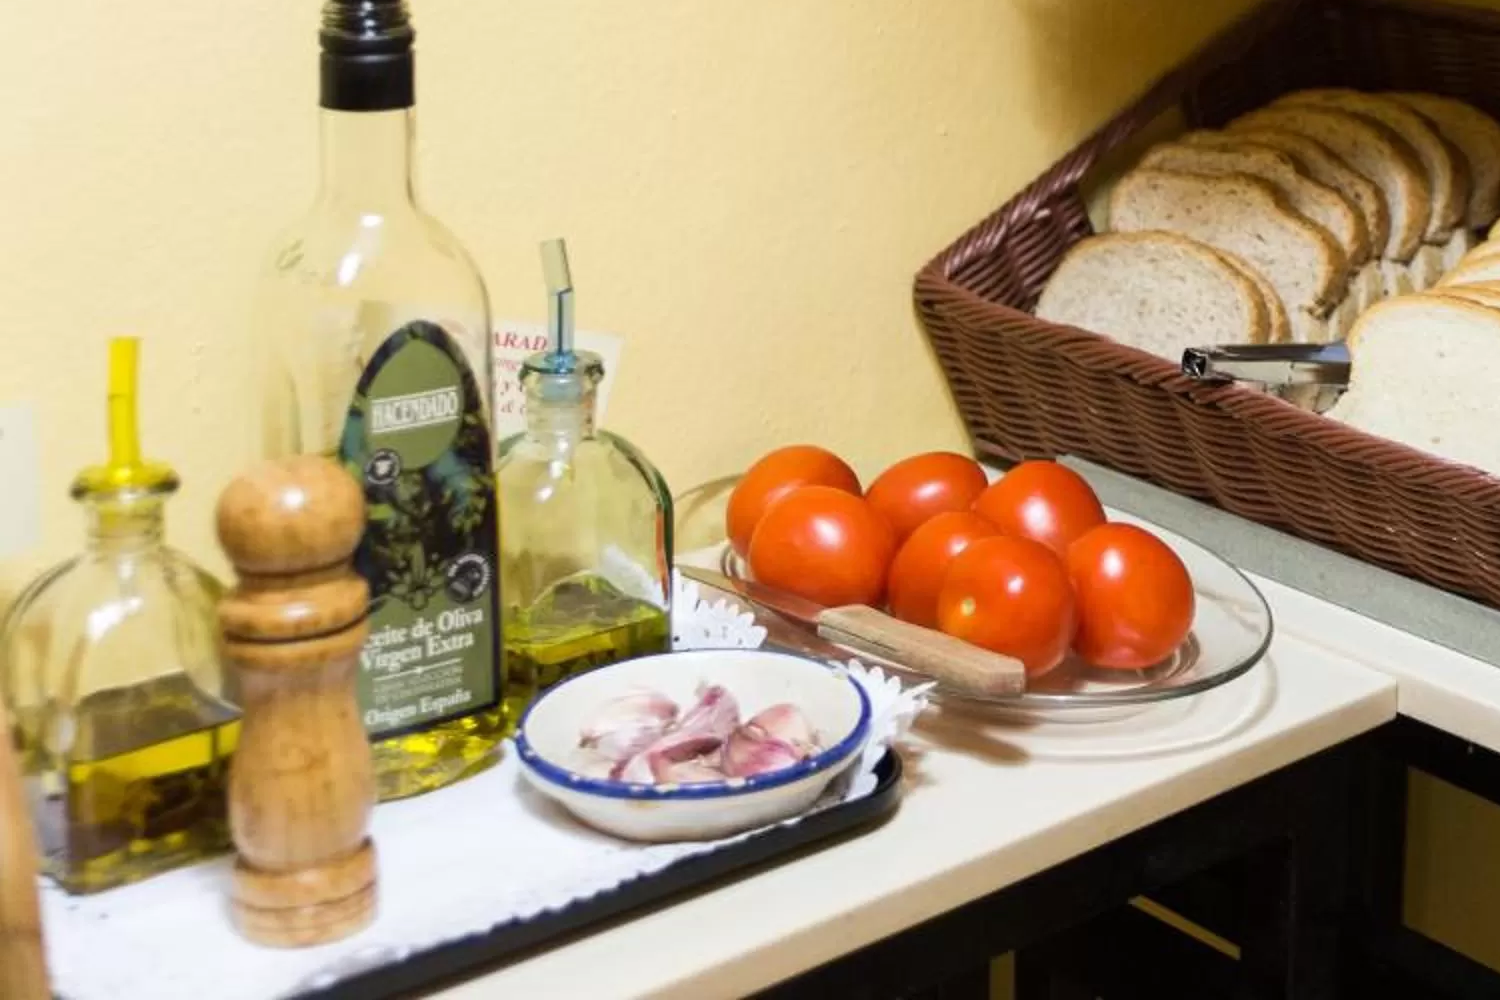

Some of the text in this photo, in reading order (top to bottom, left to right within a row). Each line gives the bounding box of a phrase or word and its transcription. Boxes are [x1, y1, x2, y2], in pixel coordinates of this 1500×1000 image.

[493, 331, 548, 351] ARAD
[372, 391, 458, 429] HACENDADO
[364, 607, 483, 648] ceite de Oliva
[361, 632, 475, 673] Virgen Extra
[364, 704, 417, 727] Origen
[420, 688, 472, 715] España
